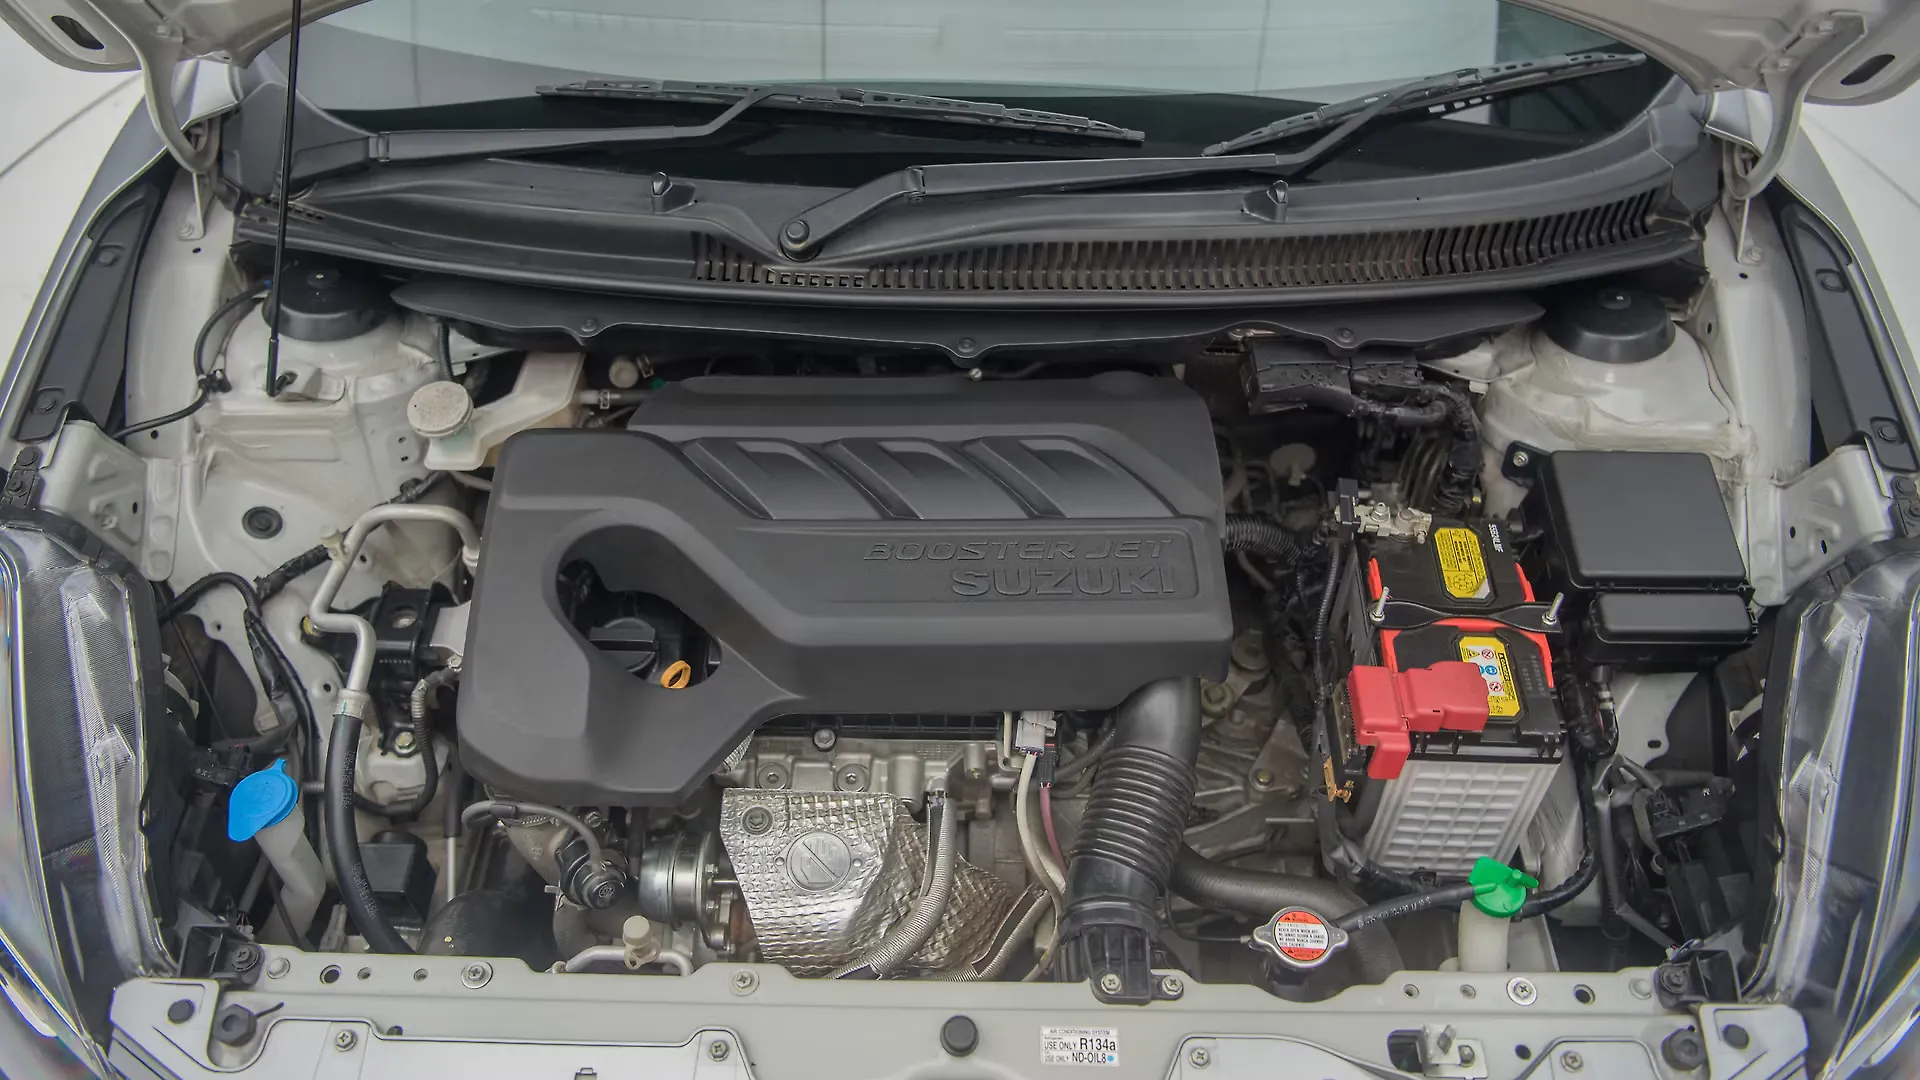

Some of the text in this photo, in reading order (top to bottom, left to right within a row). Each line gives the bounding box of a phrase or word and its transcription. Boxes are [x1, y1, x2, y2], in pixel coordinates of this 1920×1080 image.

[863, 539, 1172, 561] BOOSTER JET
[951, 566, 1176, 596] SUZUKI
[1044, 1037, 1116, 1051] USE ONLY R134a
[1072, 1052, 1107, 1064] ND-OIL8
